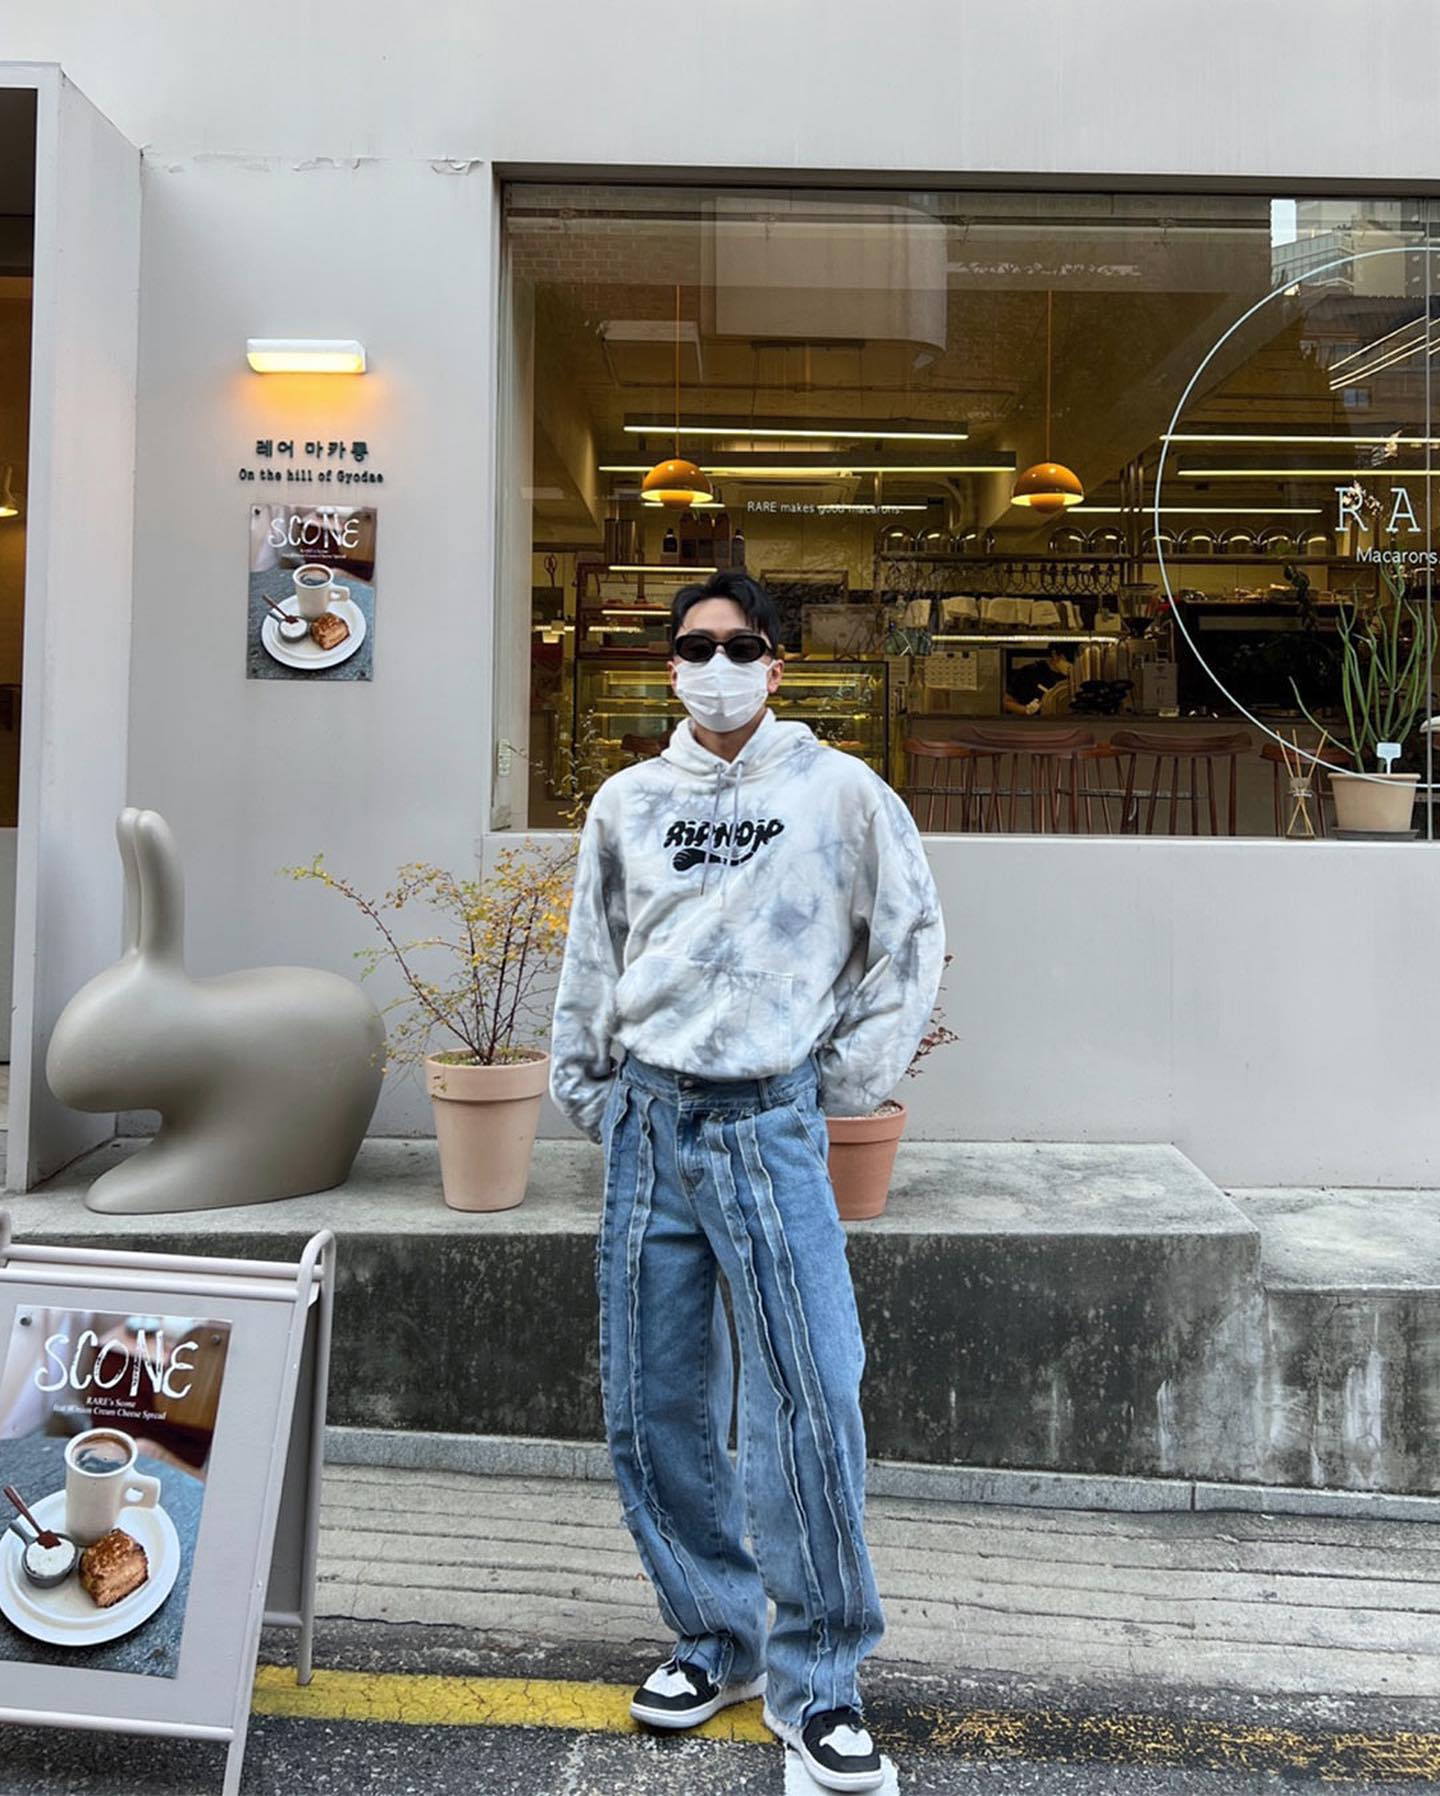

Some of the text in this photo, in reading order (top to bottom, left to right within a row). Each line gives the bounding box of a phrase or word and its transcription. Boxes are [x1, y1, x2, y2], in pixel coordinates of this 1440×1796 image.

[255, 440, 369, 462] 레어 마카롱
[239, 468, 383, 484] On the hill of Gyodae
[747, 501, 777, 513] RARE
[780, 503, 815, 513] makes
[267, 512, 360, 549] SCONE
[34, 1329, 199, 1399] SCONE
